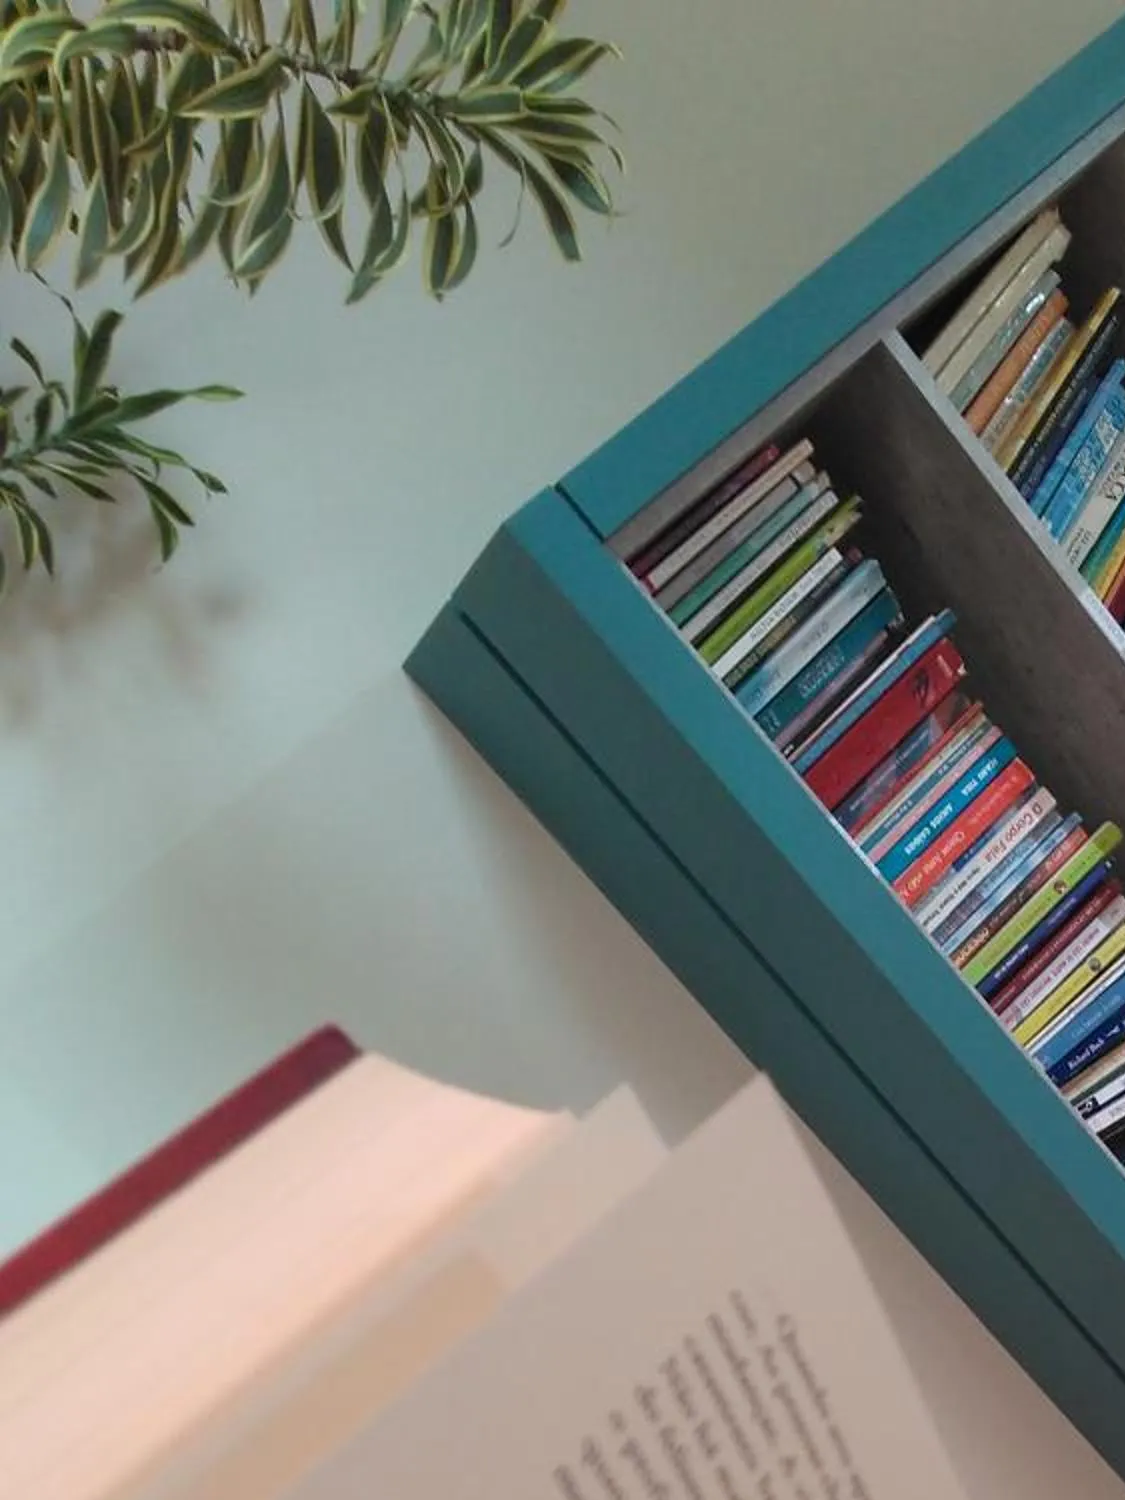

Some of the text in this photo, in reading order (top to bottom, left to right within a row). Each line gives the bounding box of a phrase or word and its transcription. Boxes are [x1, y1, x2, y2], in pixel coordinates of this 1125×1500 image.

[1030, 802, 1043, 816] O
[1002, 811, 1034, 844] Corpo
[983, 839, 1007, 864] Fala
